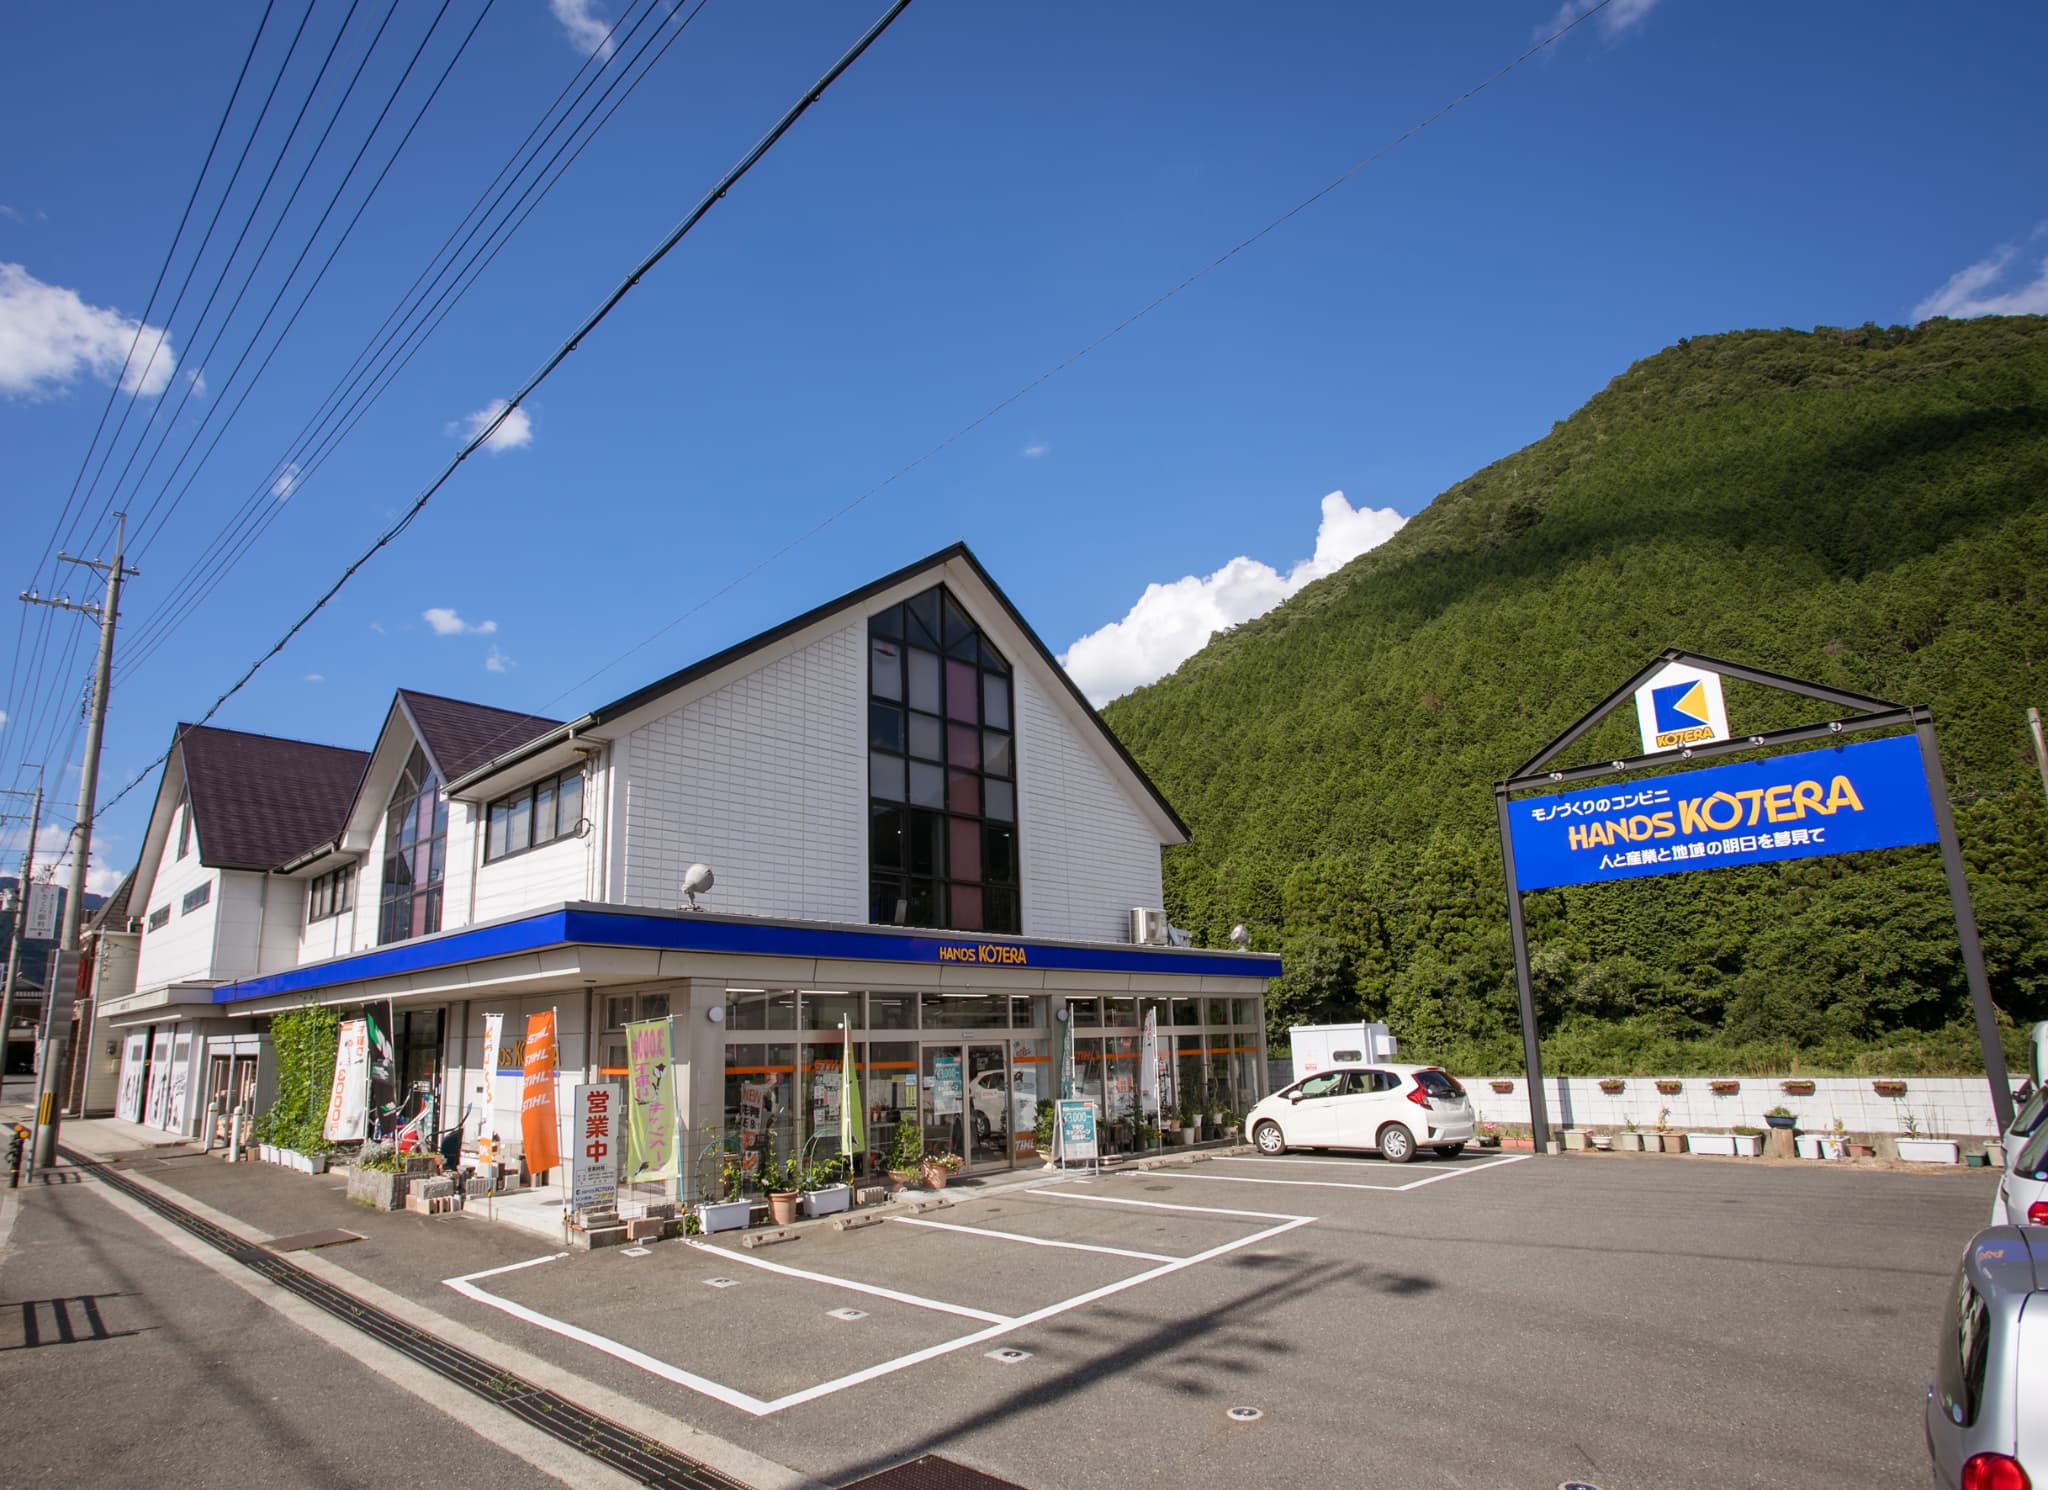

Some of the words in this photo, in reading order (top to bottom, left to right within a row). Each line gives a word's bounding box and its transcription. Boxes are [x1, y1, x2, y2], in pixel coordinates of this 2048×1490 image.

[1656, 726, 1715, 747] KOTERA
[1531, 789, 1671, 822] モノづくりのコンビニ
[1567, 811, 1676, 851] HANDS
[1678, 775, 1864, 835] KOTERA
[1599, 827, 1825, 871] 人と産業と地域の明日を夢見て
[939, 946, 976, 962] HANDS
[978, 943, 1027, 965] KOTERA
[525, 1048, 549, 1067] STIHL
[524, 1070, 549, 1088] STIHL
[522, 1093, 551, 1113] STIHL
[586, 1090, 609, 1163] 営業中
